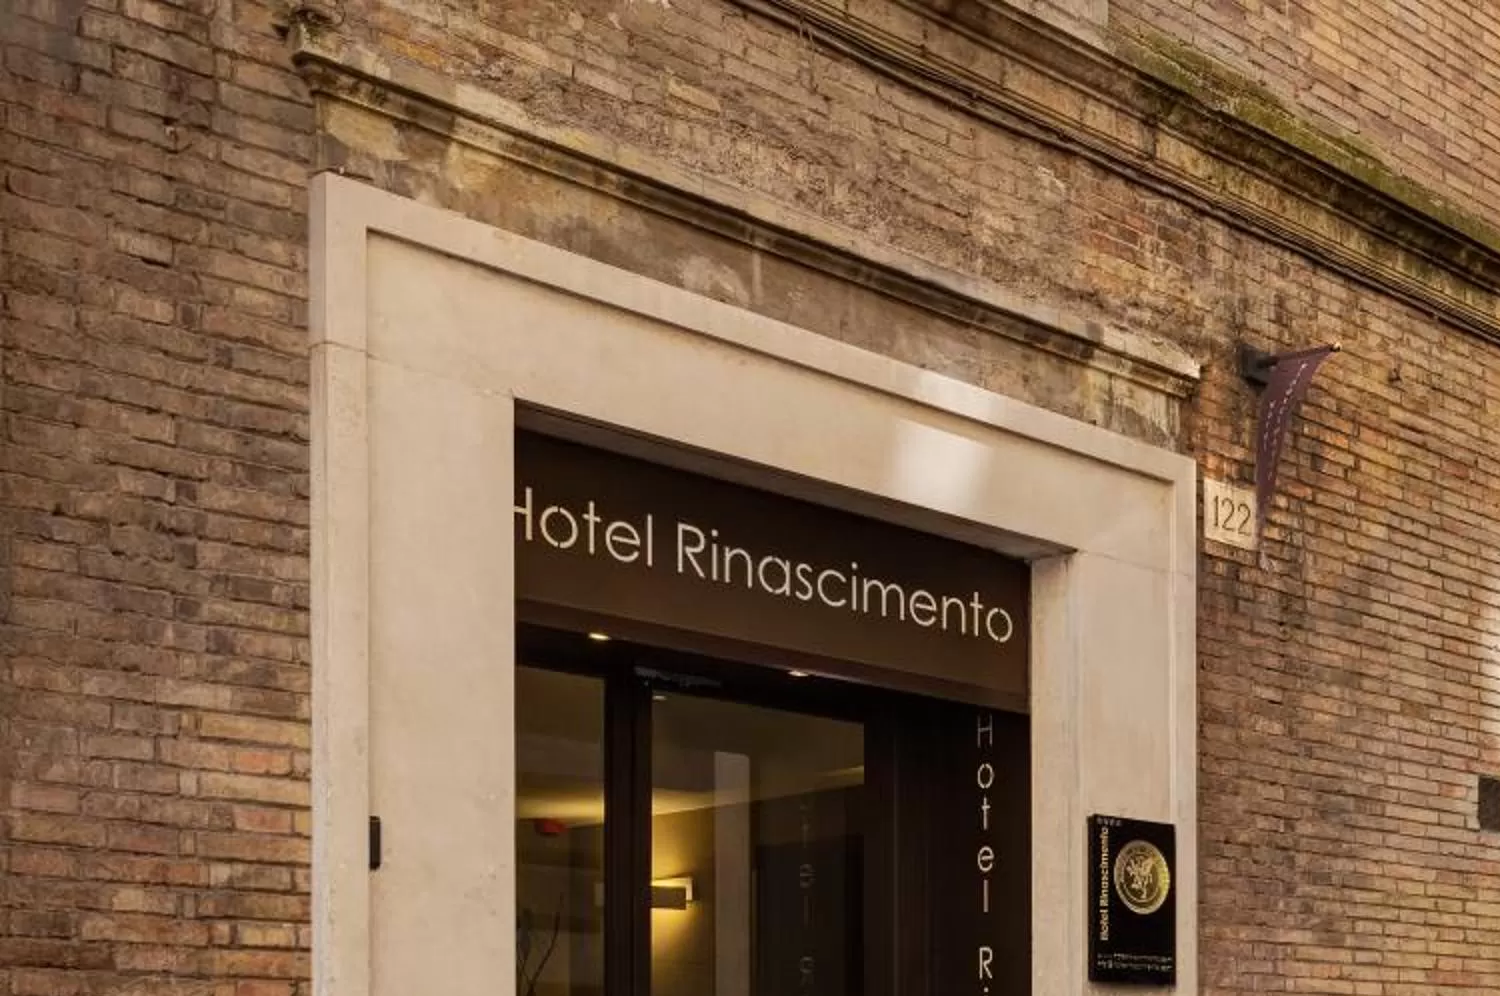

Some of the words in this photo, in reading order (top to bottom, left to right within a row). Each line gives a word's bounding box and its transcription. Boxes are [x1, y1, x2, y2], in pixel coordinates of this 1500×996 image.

[514, 486, 654, 567] Hotel
[677, 521, 1013, 643] Rinascimento
[1211, 494, 1252, 536] 122
[976, 714, 995, 913] Hotel
